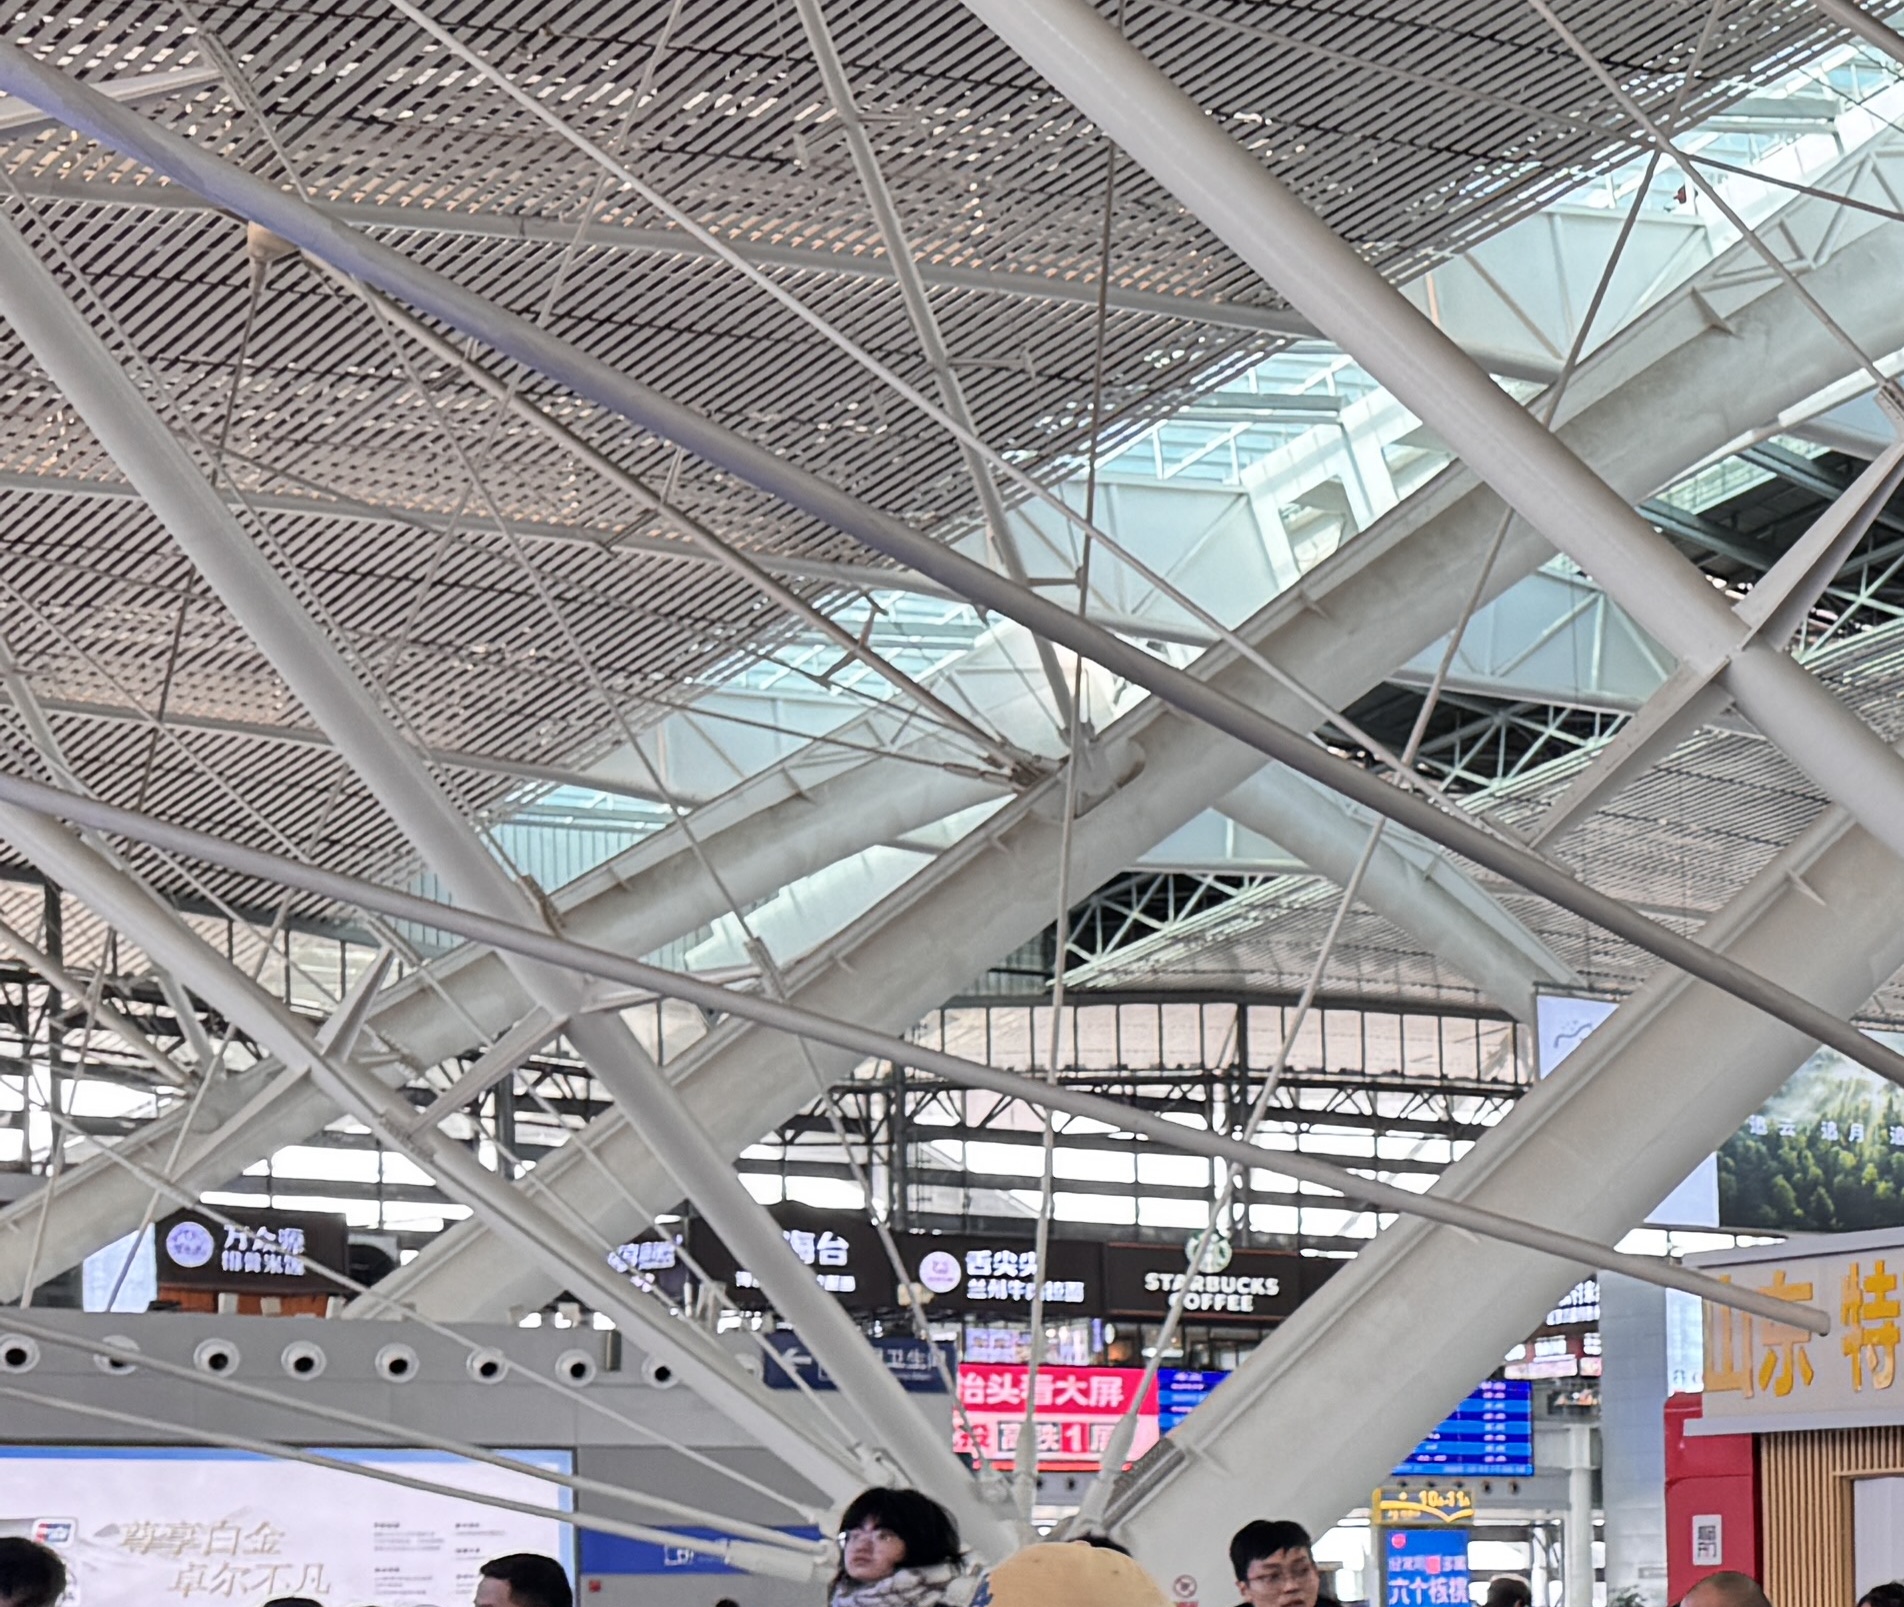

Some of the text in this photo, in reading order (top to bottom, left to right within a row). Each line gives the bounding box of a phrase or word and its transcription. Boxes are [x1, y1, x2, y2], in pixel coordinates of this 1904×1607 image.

[1144, 1272, 1280, 1296] STARBUCKS
[1168, 1294, 1254, 1312] COFFEE
[167, 1560, 331, 1597] 卓尔不凡
